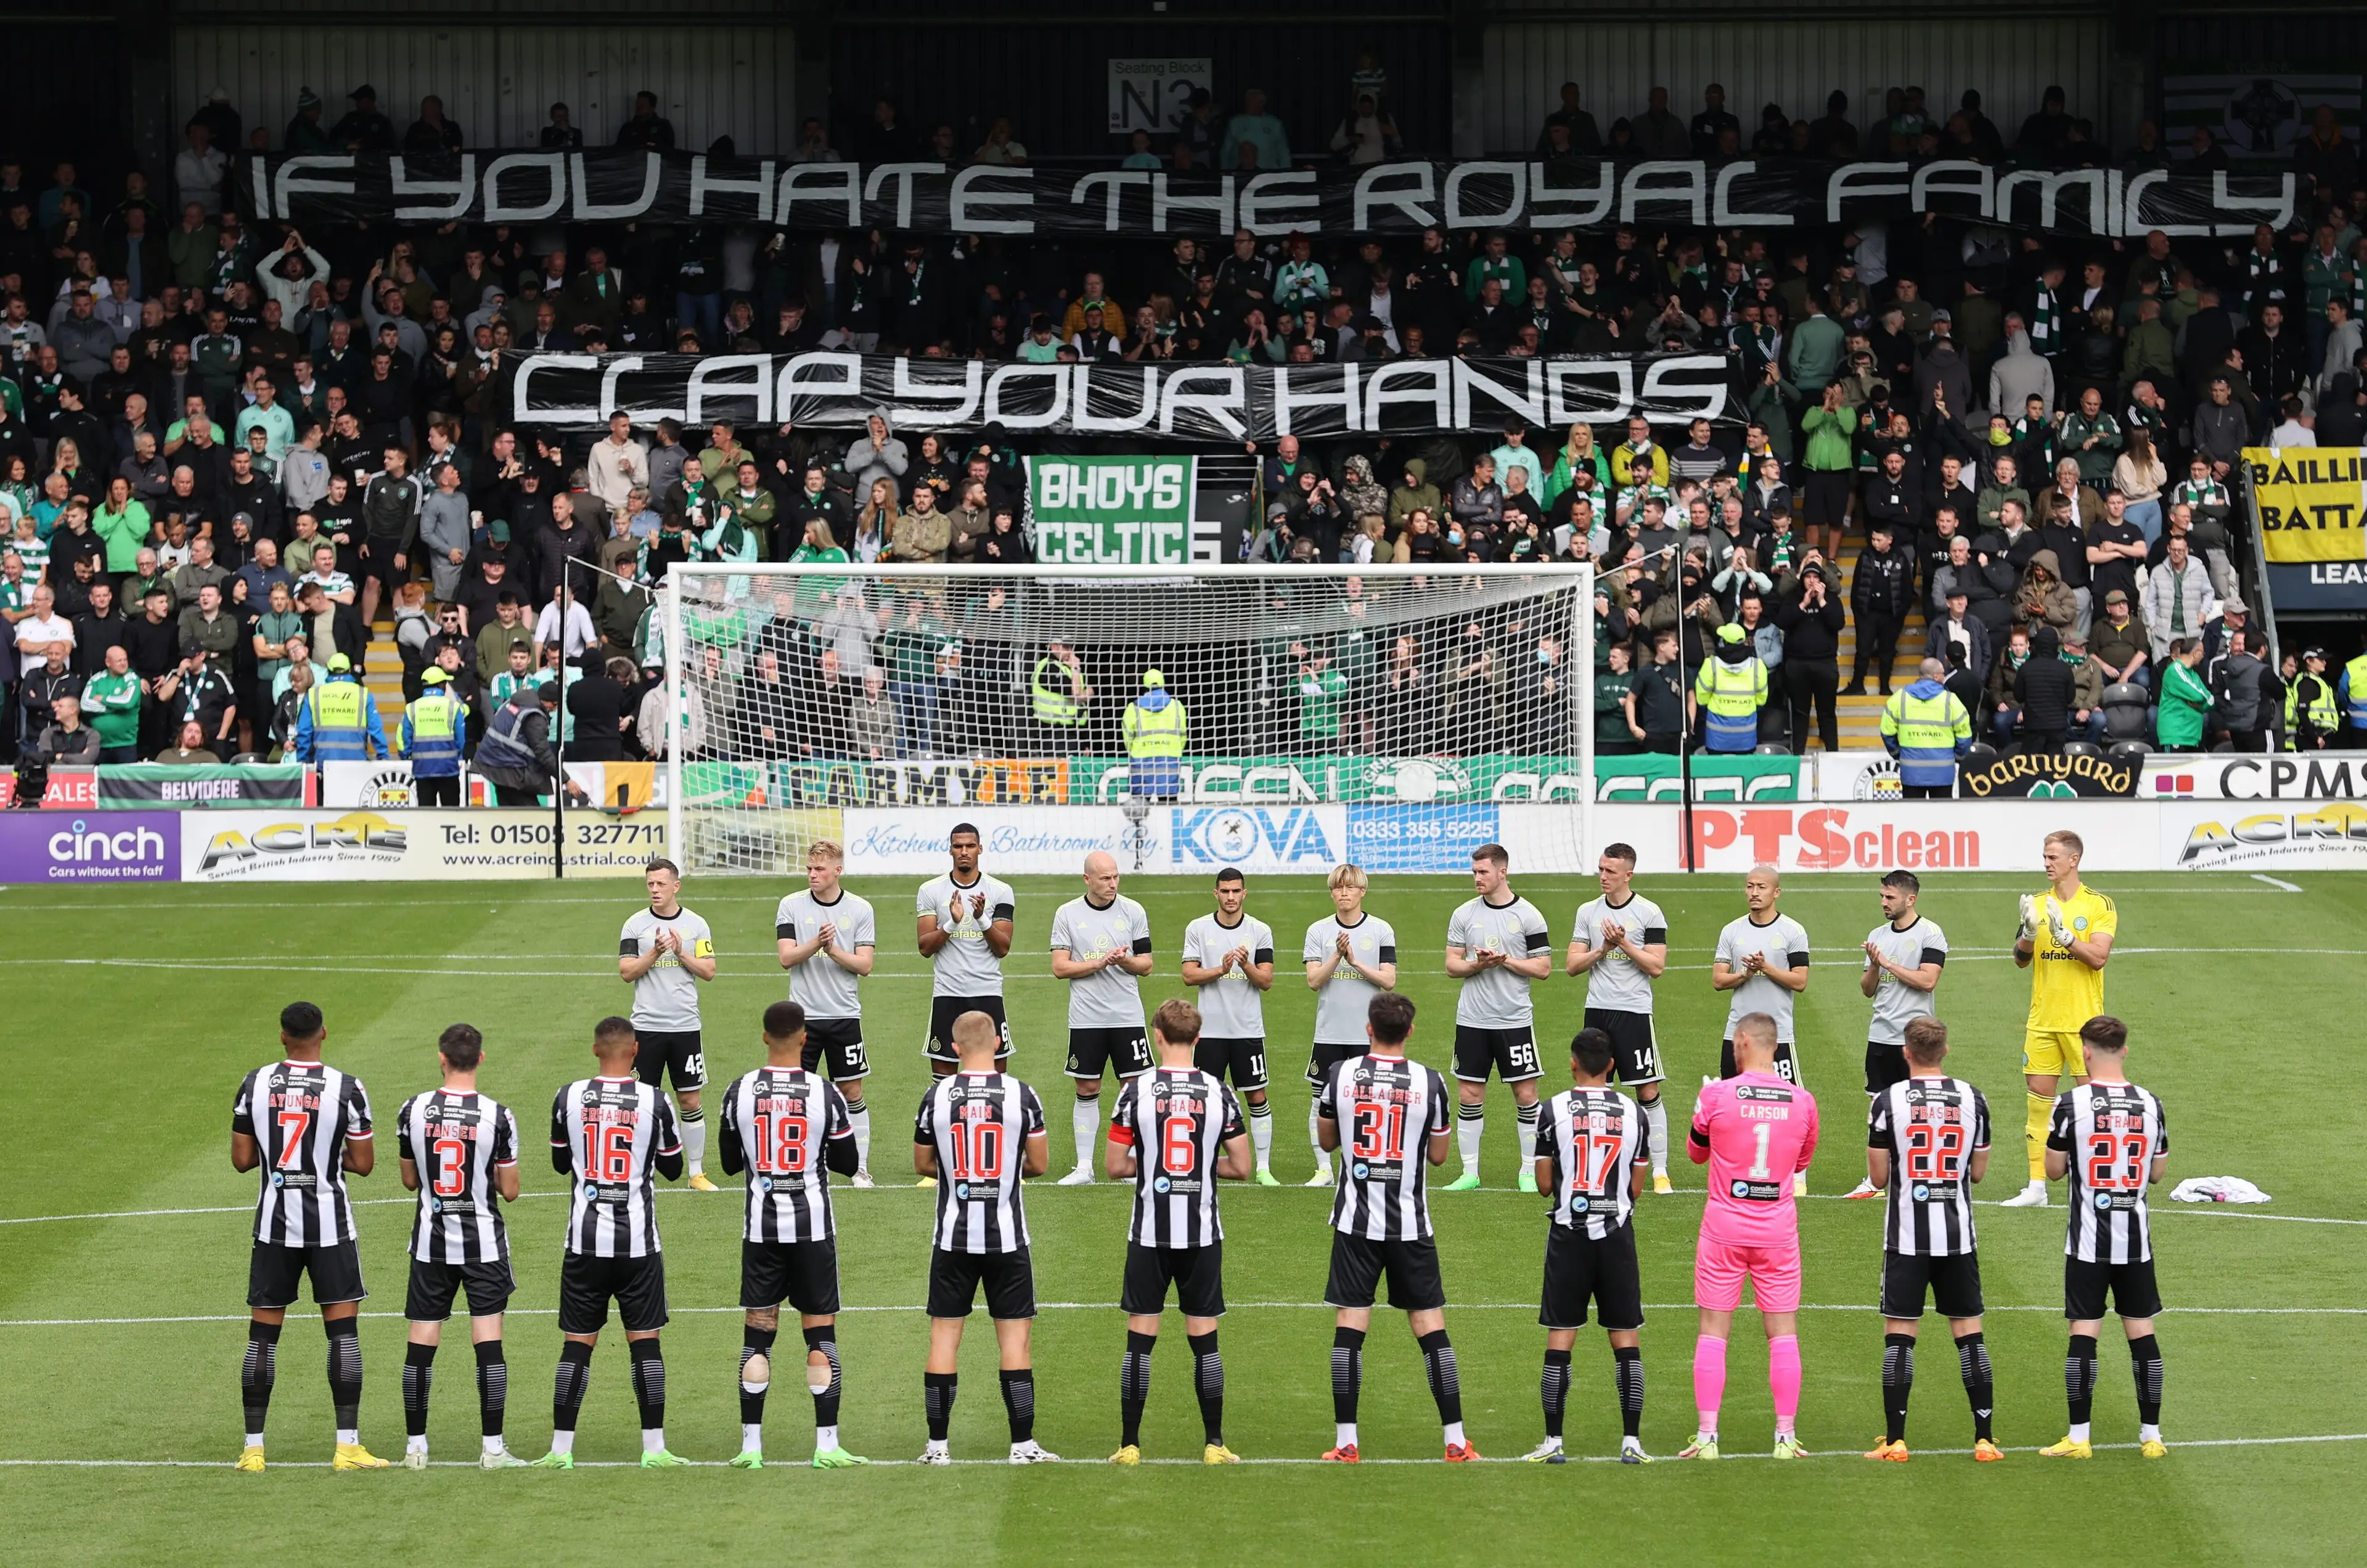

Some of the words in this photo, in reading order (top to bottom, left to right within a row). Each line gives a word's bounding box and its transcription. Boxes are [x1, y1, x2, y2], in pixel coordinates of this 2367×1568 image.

[1115, 62, 1164, 76] Seating
[1169, 62, 1205, 73] Block
[1122, 80, 1196, 128] N3
[251, 155, 356, 219] IF
[390, 152, 661, 222] YOU
[689, 155, 1035, 234] HATE
[1071, 171, 1321, 236] THE
[890, 357, 1248, 439] YOUR
[1273, 354, 1728, 436] HANDS
[1039, 463, 1183, 510] BHOYS
[1036, 522, 1183, 564] CELTIC
[2311, 563, 2367, 584] LEA
[161, 779, 239, 801] BELVIDERE
[2220, 759, 2367, 799] CPM
[43, 782, 96, 802] ALES
[48, 819, 164, 861] cinch
[440, 823, 480, 844] Tel:
[577, 824, 664, 844] 327711
[989, 825, 1114, 854] Bathrooms
[1172, 808, 1336, 864] KOVA
[1352, 820, 1400, 838] 0333
[1405, 820, 1442, 838] 355
[1446, 820, 1494, 838] 5225
[196, 823, 407, 874] ACRE
[2230, 850, 2266, 863] British
[2269, 845, 2313, 855] Industry
[2317, 844, 2348, 852] Since
[49, 866, 76, 878] Cars
[77, 865, 121, 877] without
[122, 865, 141, 876] the
[142, 865, 163, 876] faff
[207, 868, 246, 880] Serving
[249, 858, 285, 872] British
[288, 854, 333, 865] Industry
[337, 852, 366, 862] Since
[705, 941, 713, 953] C
[844, 1042, 865, 1066] 57
[1131, 1038, 1149, 1060] 13
[1509, 1043, 1534, 1066] 56
[1634, 1048, 1653, 1070] 14
[685, 1053, 703, 1075] 42
[1249, 1053, 1265, 1076] 11
[269, 1093, 319, 1110] AYUNGA
[757, 1098, 803, 1113] DUNNE
[1343, 1084, 1421, 1105] GALLAGHER
[581, 1108, 639, 1124] ERHAHON
[959, 1105, 992, 1120] MAIN
[1156, 1099, 1204, 1114] O'HARA
[1740, 1104, 1789, 1121] CARSON
[1911, 1106, 1960, 1121] FRASER
[425, 1124, 476, 1140] TANSER
[1352, 1101, 1404, 1161] 31
[1573, 1116, 1623, 1131] BACCUS
[2096, 1114, 2143, 1130] STRAIN
[277, 1109, 310, 1169] 7
[753, 1114, 809, 1172] 18
[1162, 1116, 1196, 1174] 6
[582, 1122, 634, 1183] 16
[949, 1122, 1004, 1180] 10
[1749, 1122, 1770, 1179] 1
[1905, 1123, 1966, 1180] 22
[2088, 1132, 2149, 1190] 23
[433, 1138, 465, 1196] 3
[1572, 1134, 1623, 1191] 17
[599, 1188, 629, 1196] consilium
[773, 1178, 804, 1186] consilium
[1750, 1185, 1779, 1193] consilium
